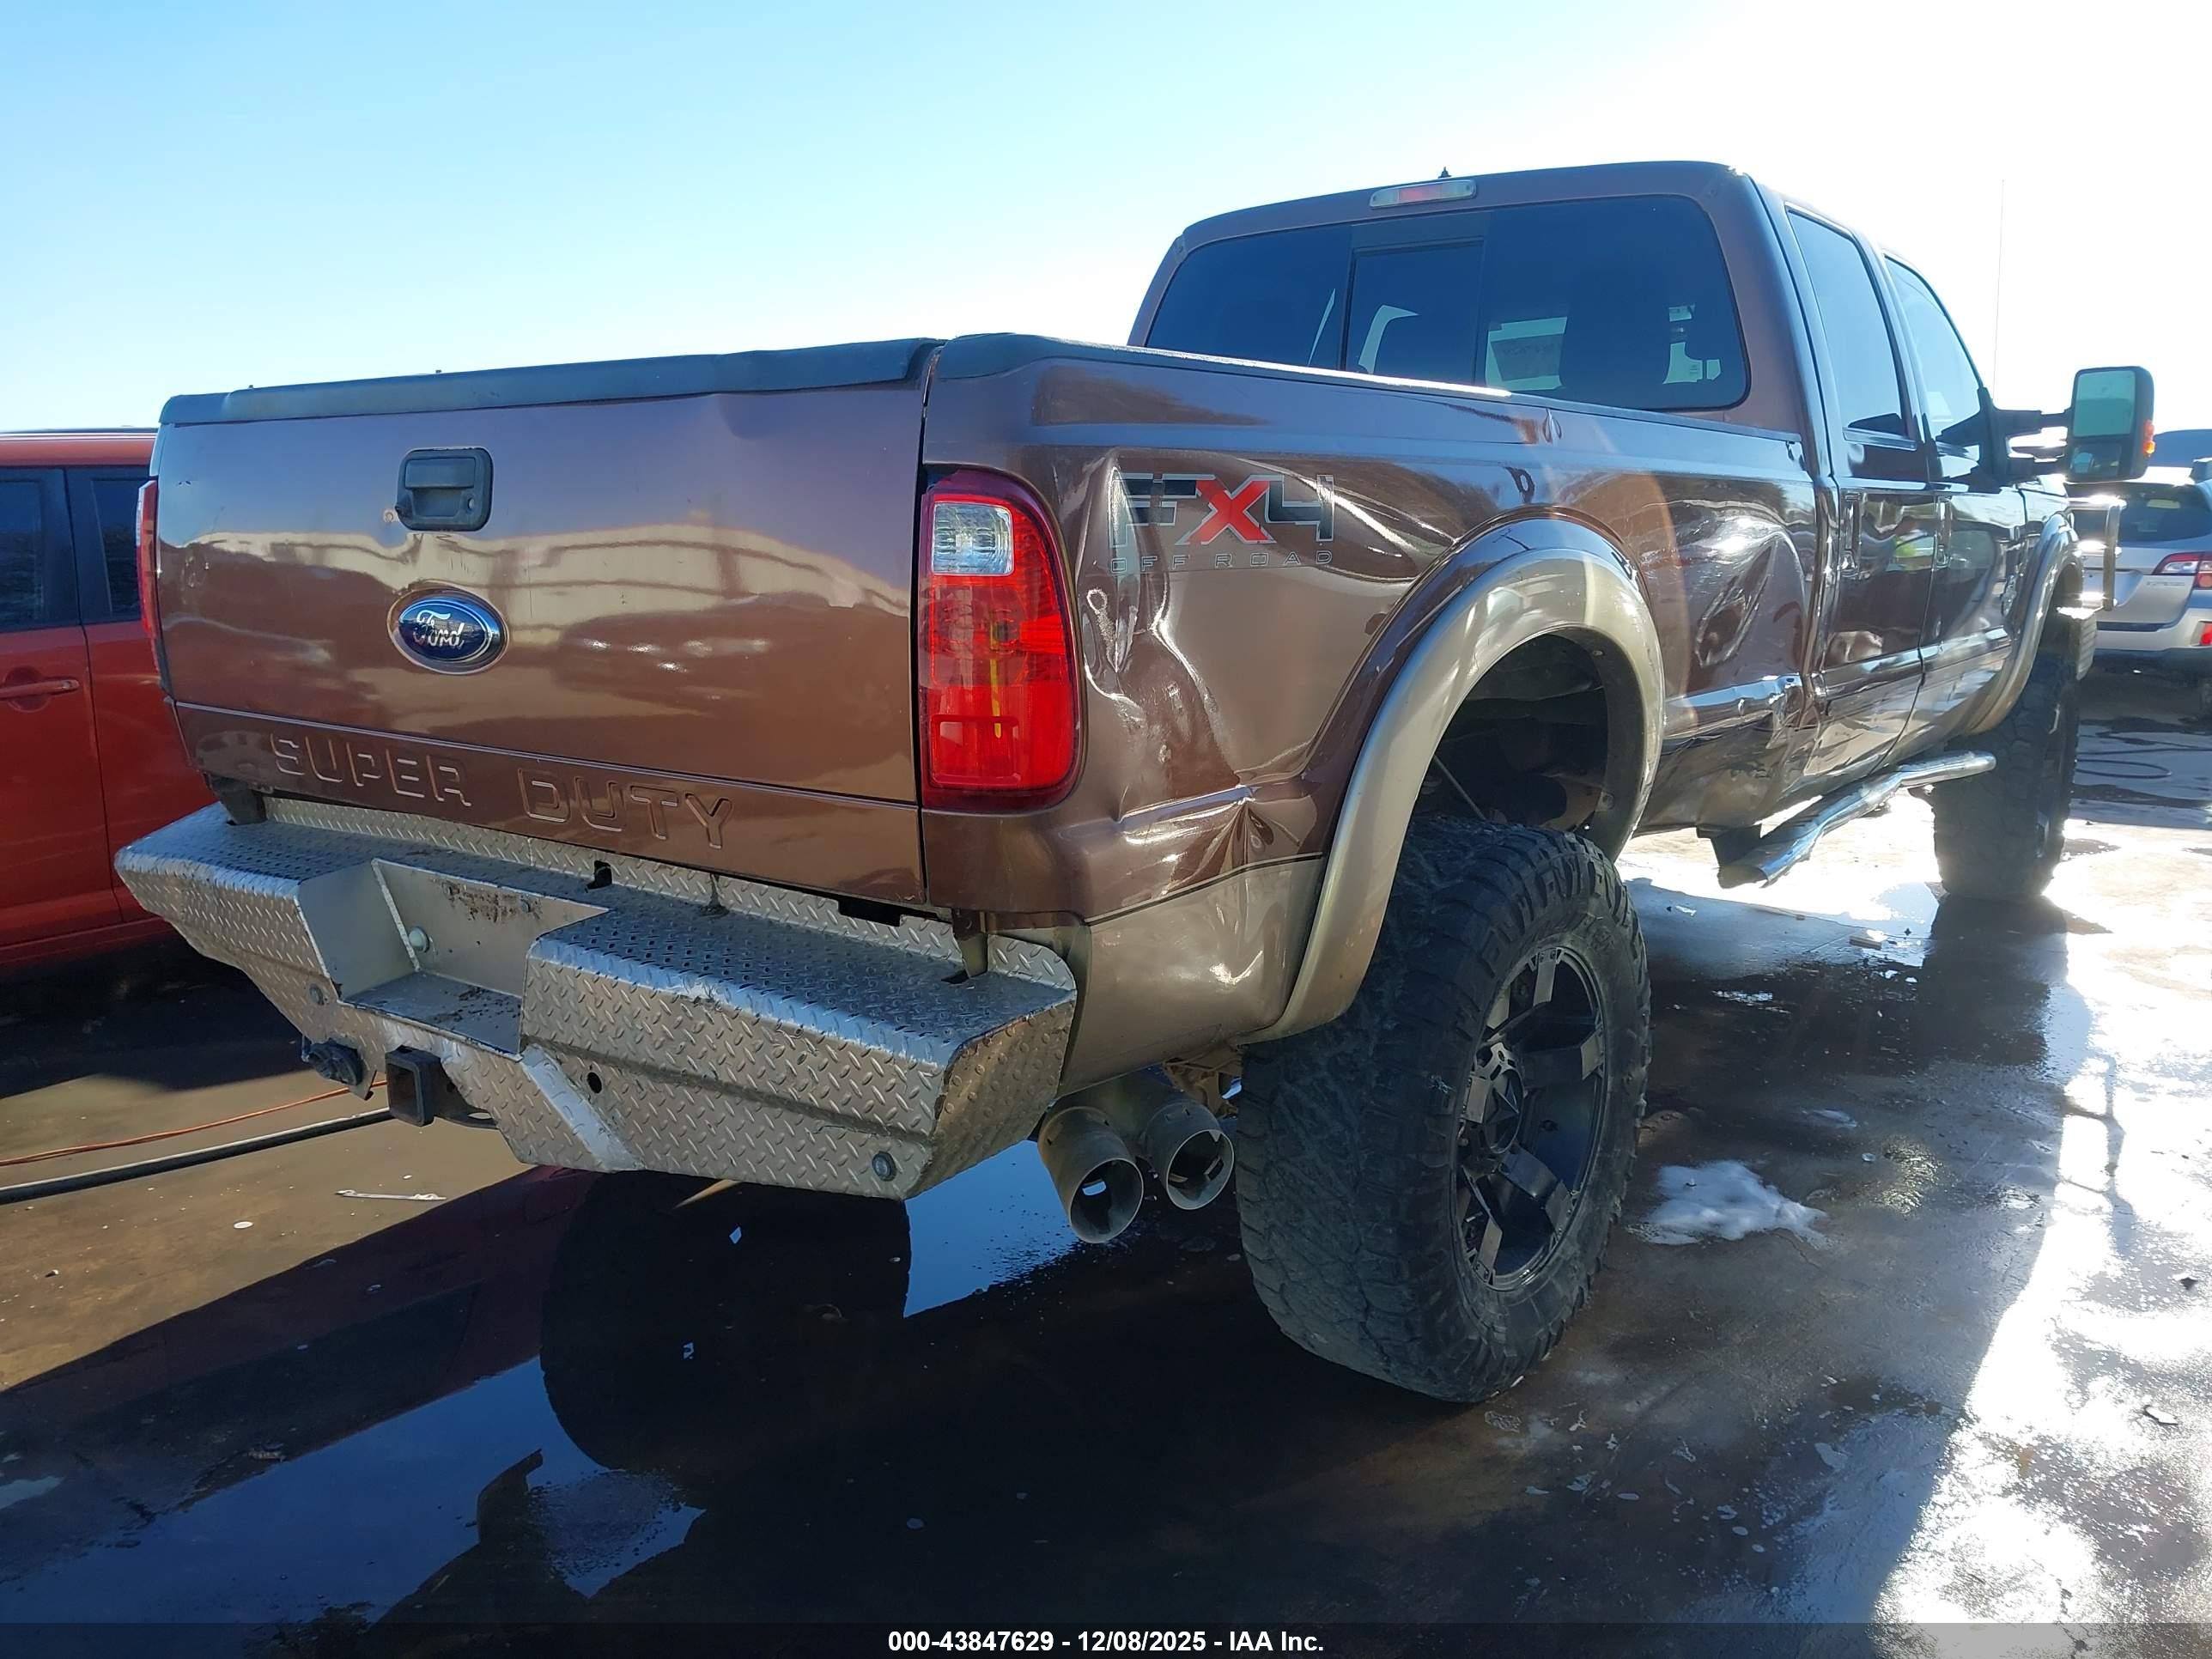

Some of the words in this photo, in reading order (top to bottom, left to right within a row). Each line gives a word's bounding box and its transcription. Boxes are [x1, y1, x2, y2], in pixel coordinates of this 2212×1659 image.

[1108, 473, 1334, 549] FX4
[1111, 554, 1189, 574] OFF
[1214, 550, 1333, 568] ROAD
[412, 609, 465, 651] Ford
[270, 732, 472, 807] SUPER
[517, 766, 732, 849] DUTY
